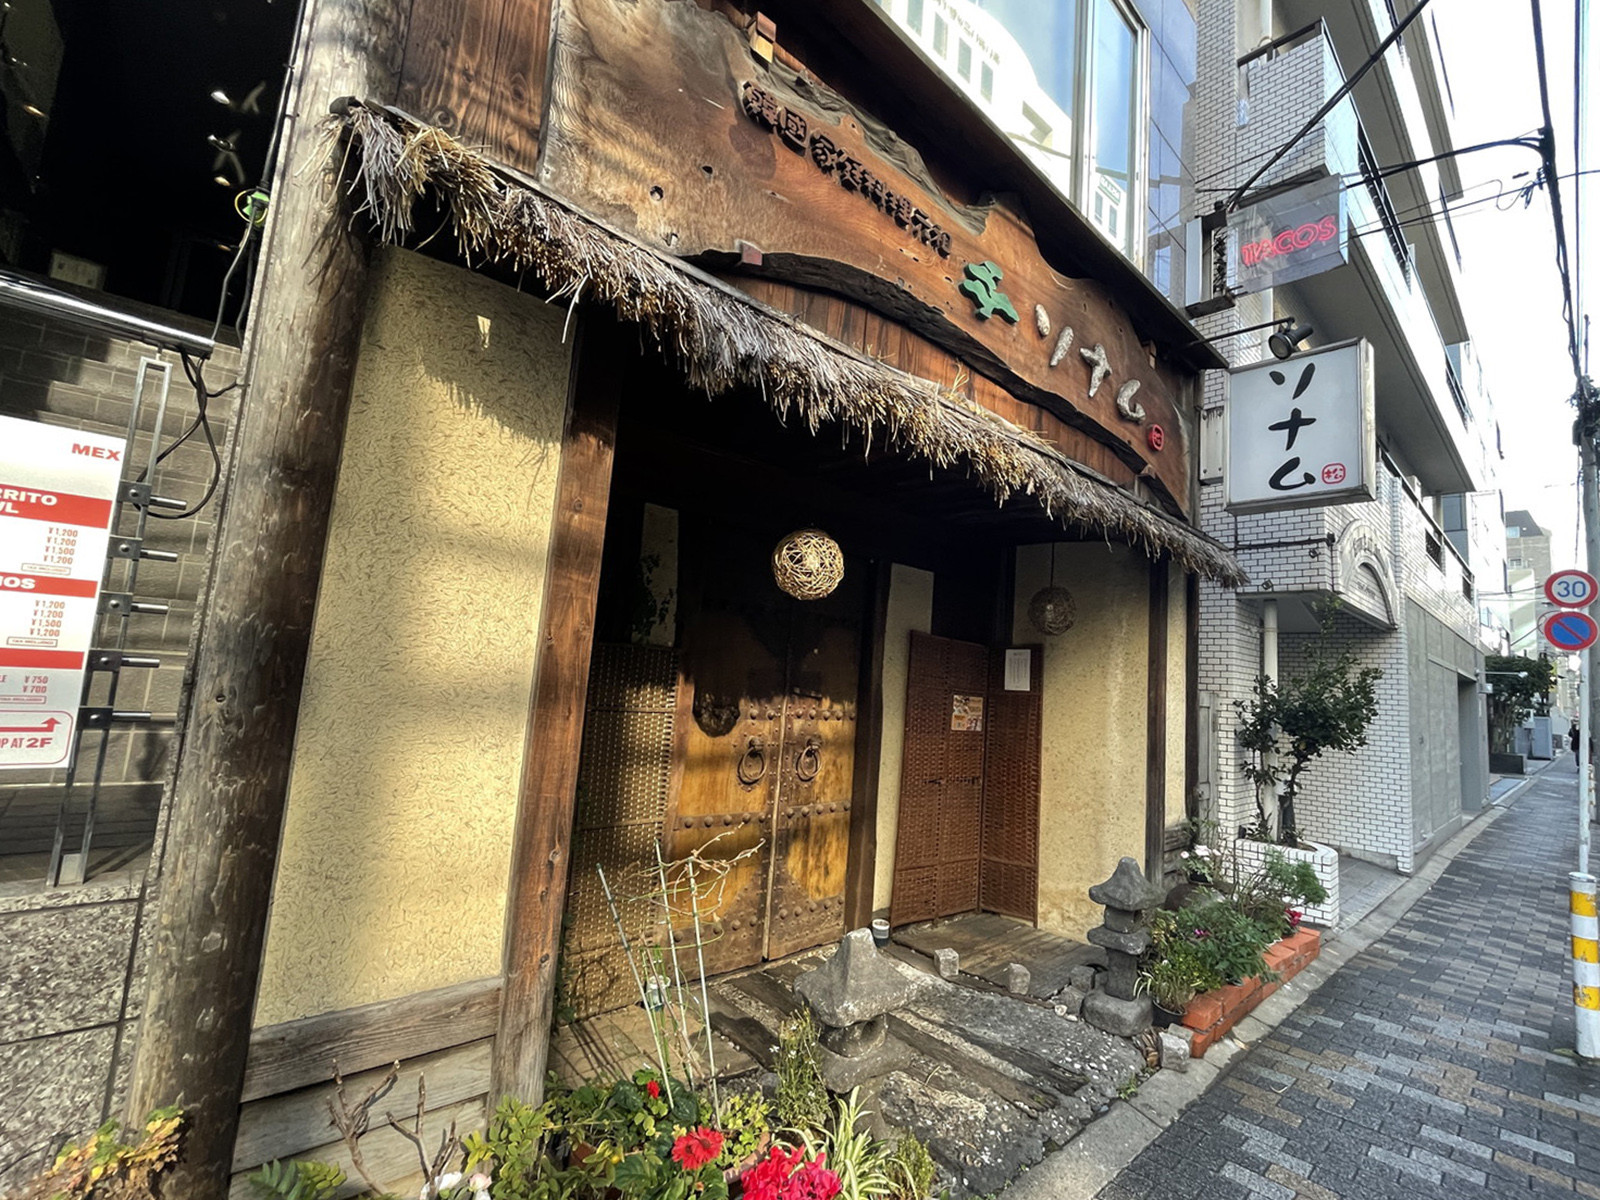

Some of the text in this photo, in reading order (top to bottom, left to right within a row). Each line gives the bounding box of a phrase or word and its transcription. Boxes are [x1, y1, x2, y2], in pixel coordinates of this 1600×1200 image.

[1240, 215, 1337, 266] TACOS
[72, 443, 121, 461] MEX
[0, 488, 57, 506] RITO
[1557, 581, 1587, 598] 30
[10, 737, 25, 749] AT
[26, 737, 53, 749] 2F
